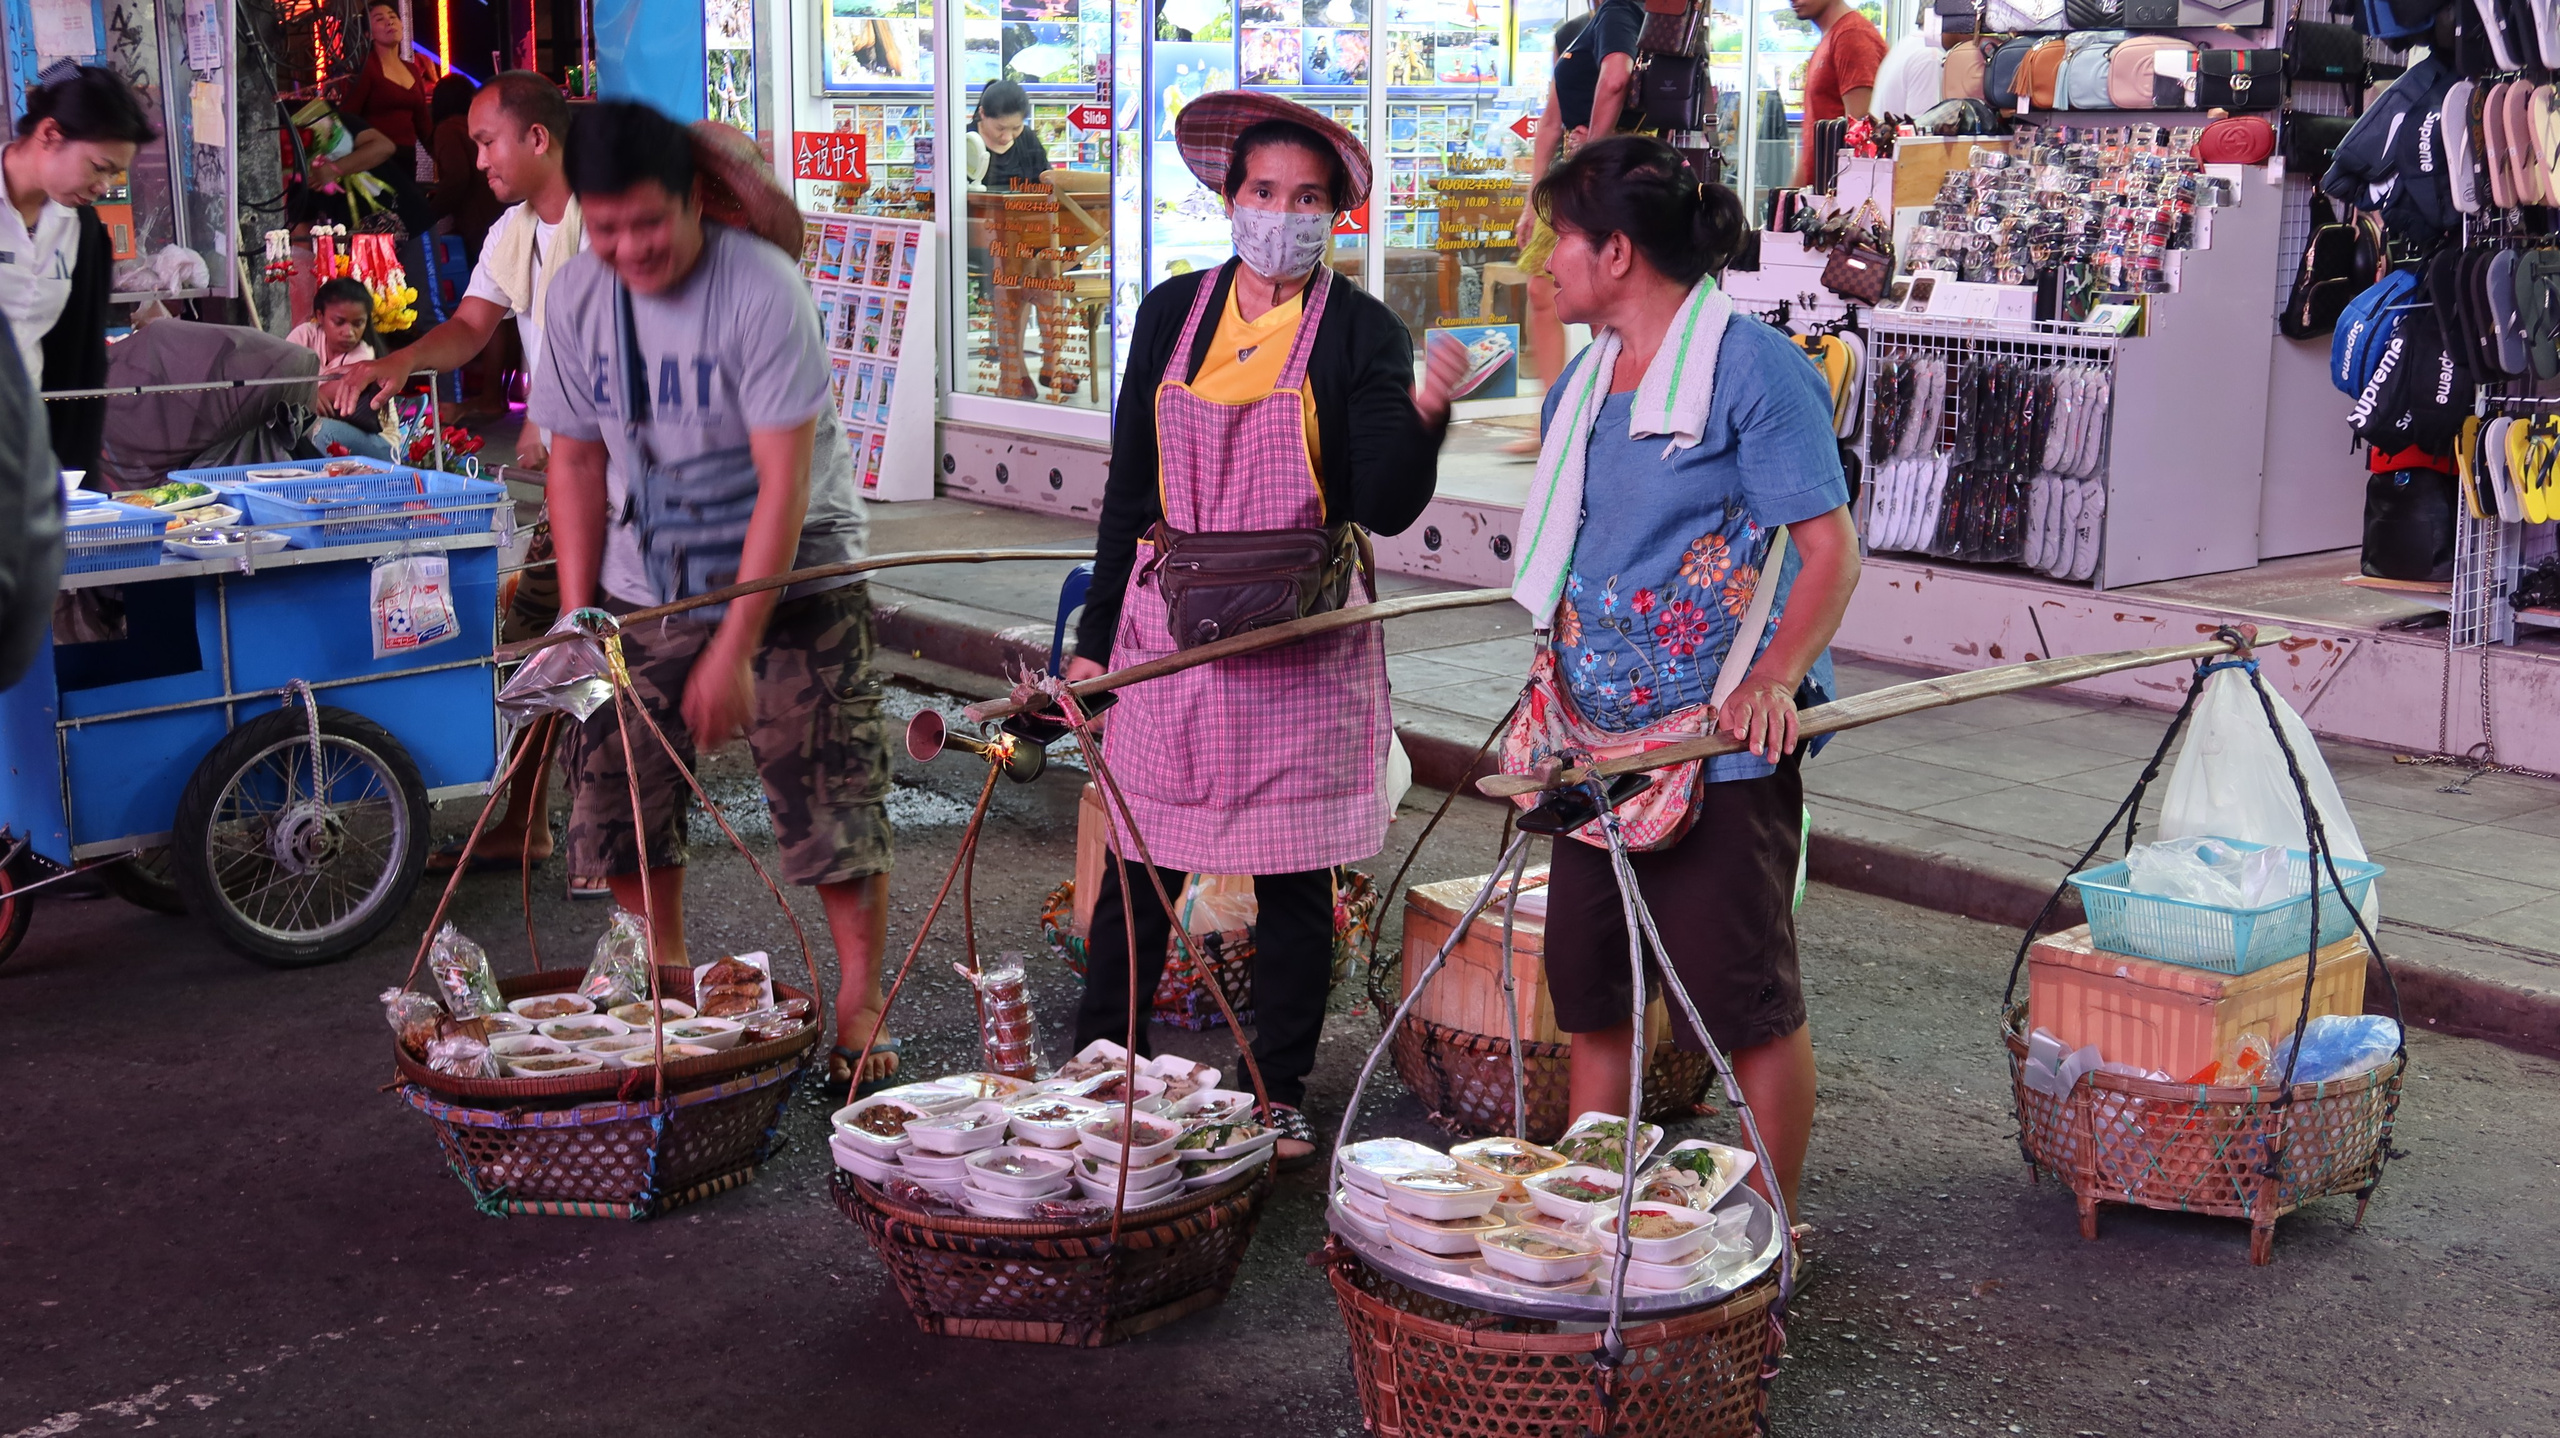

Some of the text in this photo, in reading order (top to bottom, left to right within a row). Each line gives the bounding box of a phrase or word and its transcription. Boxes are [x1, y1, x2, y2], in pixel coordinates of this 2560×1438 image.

[1083, 110, 1107, 125] Slide
[2418, 111, 2441, 173] Supreme
[797, 136, 863, 179] 会说中文
[1448, 152, 1507, 172] Welcome
[1009, 176, 1054, 194] Welcome
[1437, 178, 1513, 191] 0960244349
[1005, 201, 1060, 212] 0960244349
[1482, 219, 1515, 232] Island
[990, 240, 1009, 258] Phi
[1016, 242, 1035, 260] Phi
[1436, 236, 1518, 251] Bamboo Island
[993, 269, 1076, 292] Boat timetable
[1488, 313, 1508, 324] Boat
[2341, 320, 2365, 382] Supreme
[2346, 337, 2405, 429] Supreme
